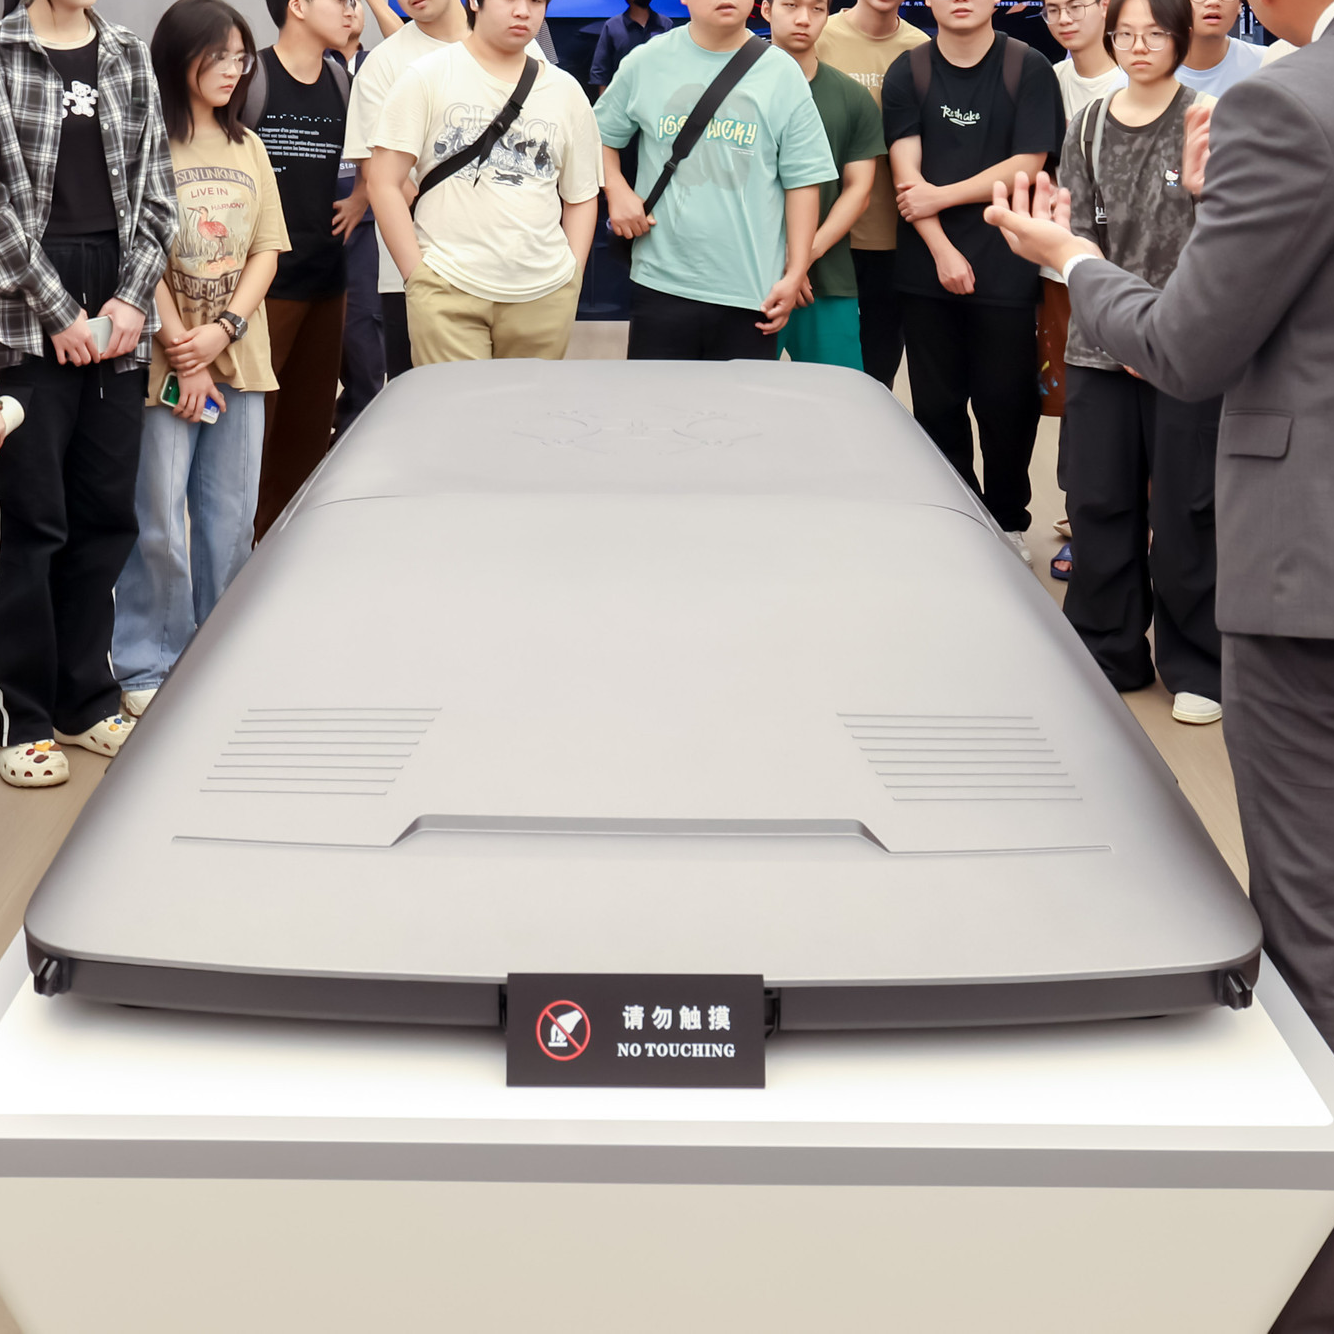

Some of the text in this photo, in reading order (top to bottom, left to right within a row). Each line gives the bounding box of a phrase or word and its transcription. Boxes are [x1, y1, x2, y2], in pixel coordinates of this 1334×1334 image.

[443, 102, 558, 150] GUCI
[190, 187, 229, 199] LIVE IN
[622, 1005, 731, 1031] 请勿触摸
[617, 1042, 735, 1058] NO TOUCHING
